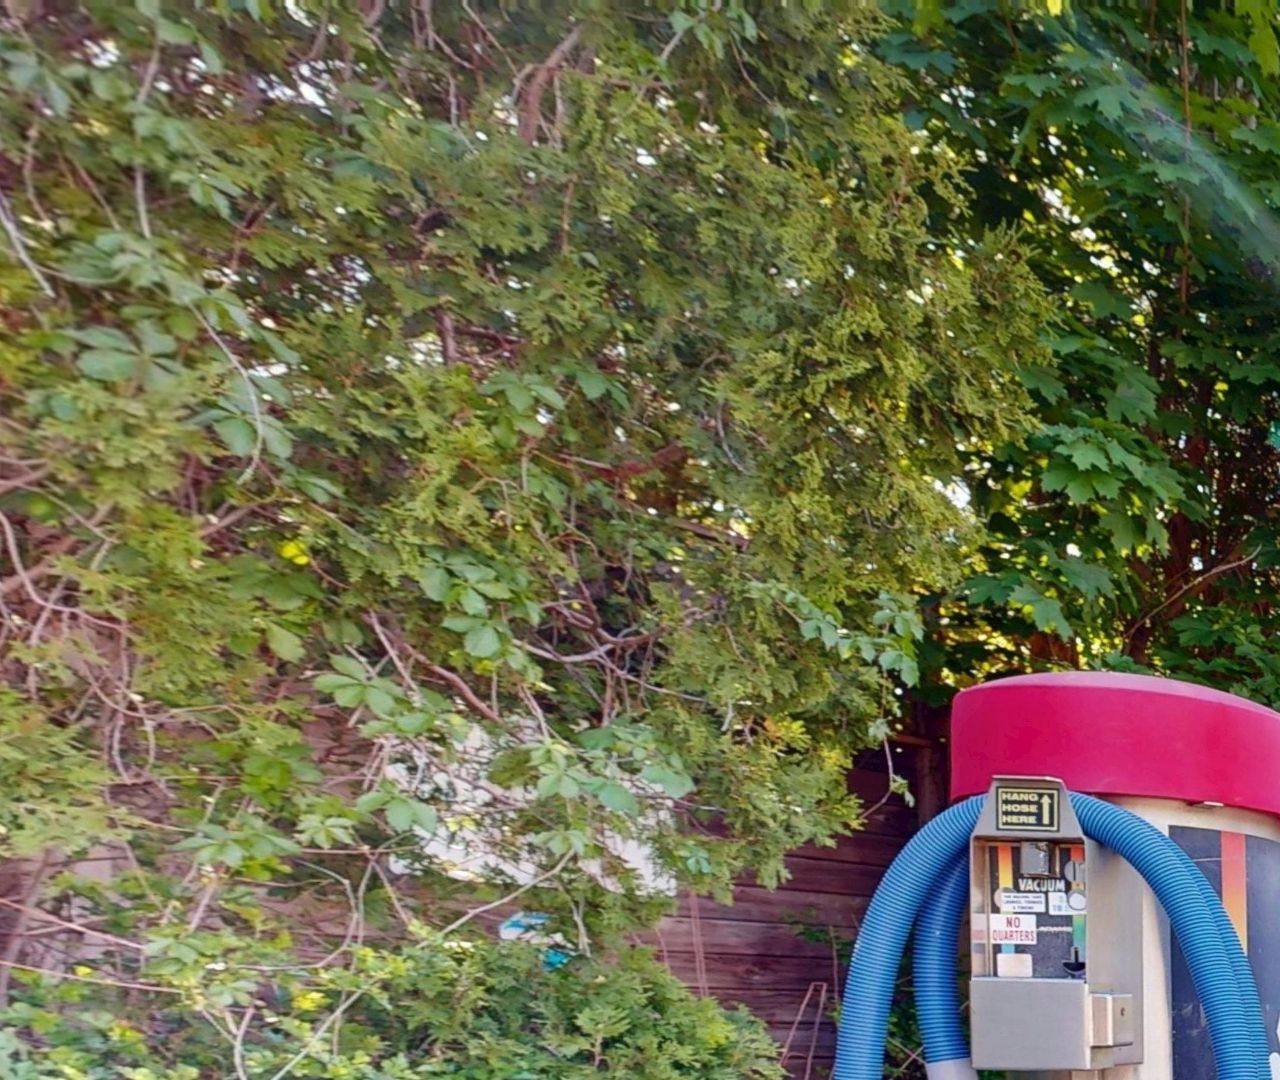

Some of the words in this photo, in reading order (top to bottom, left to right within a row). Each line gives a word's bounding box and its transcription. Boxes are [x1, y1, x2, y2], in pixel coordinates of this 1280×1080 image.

[1002, 793, 1038, 801] HANG
[1002, 804, 1038, 813] HOSE
[1002, 815, 1037, 824] HERE
[1018, 879, 1066, 892] VACUUM
[1006, 917, 1020, 928] NO
[992, 929, 1034, 941] QUARTERS
